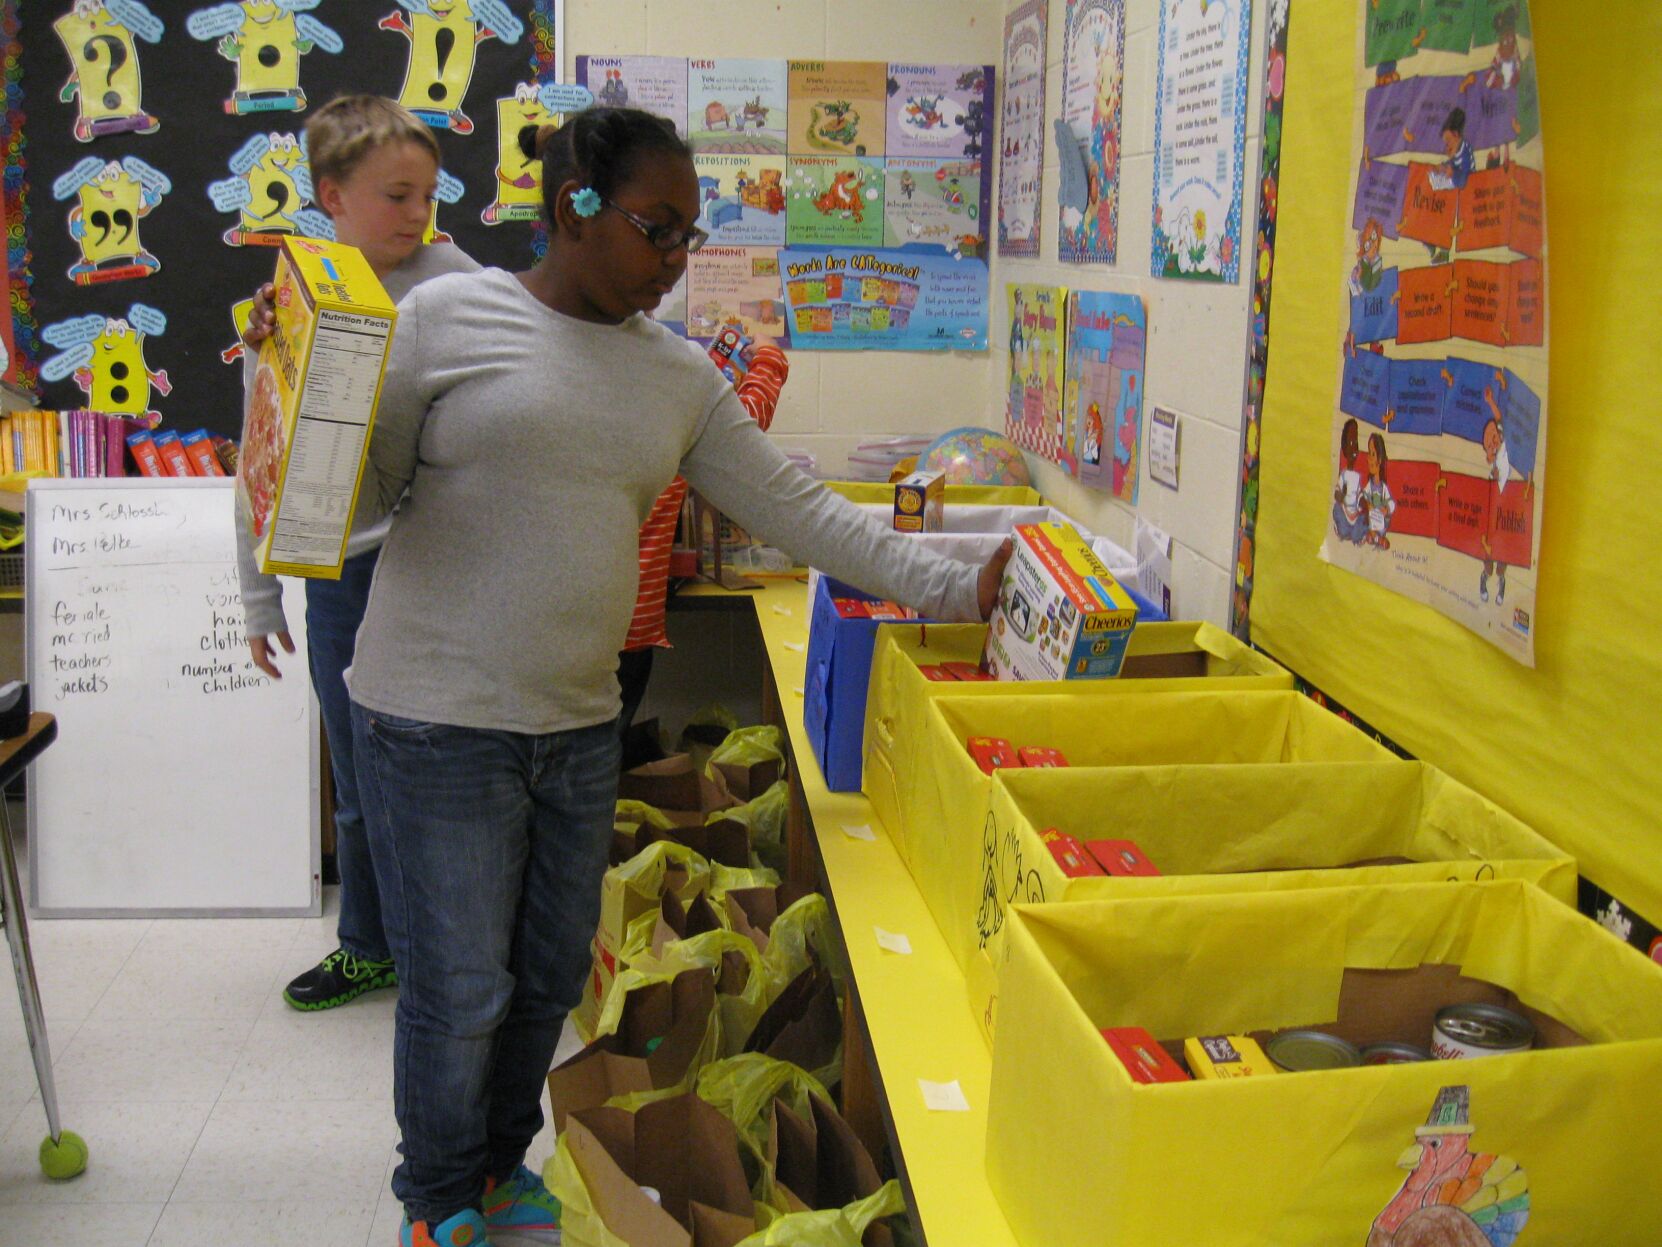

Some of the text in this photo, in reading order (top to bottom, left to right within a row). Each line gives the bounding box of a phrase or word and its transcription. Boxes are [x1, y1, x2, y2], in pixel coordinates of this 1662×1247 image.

[591, 59, 622, 67] NOUNS
[692, 61, 715, 70] VERBS
[791, 63, 825, 72] ADVERBS
[890, 66, 936, 75] PRONOUNS
[694, 156, 750, 166] REPOSITIONS
[789, 158, 838, 166] SYNONYMS
[888, 160, 937, 168] ANTONYMS
[1414, 185, 1446, 213] Revise
[510, 210, 538, 219] Apostrop
[787, 255, 920, 280] Words Are CATegorical
[1364, 297, 1384, 318] Edit
[321, 312, 389, 329] Nutrition Facts
[53, 504, 90, 521] Mrs
[1497, 507, 1526, 534] Publish
[53, 536, 86, 556] Mrs
[1085, 615, 1132, 629] Cheerios
[50, 653, 111, 671] teachers
[56, 674, 108, 701] jackets
[203, 675, 271, 694] children
